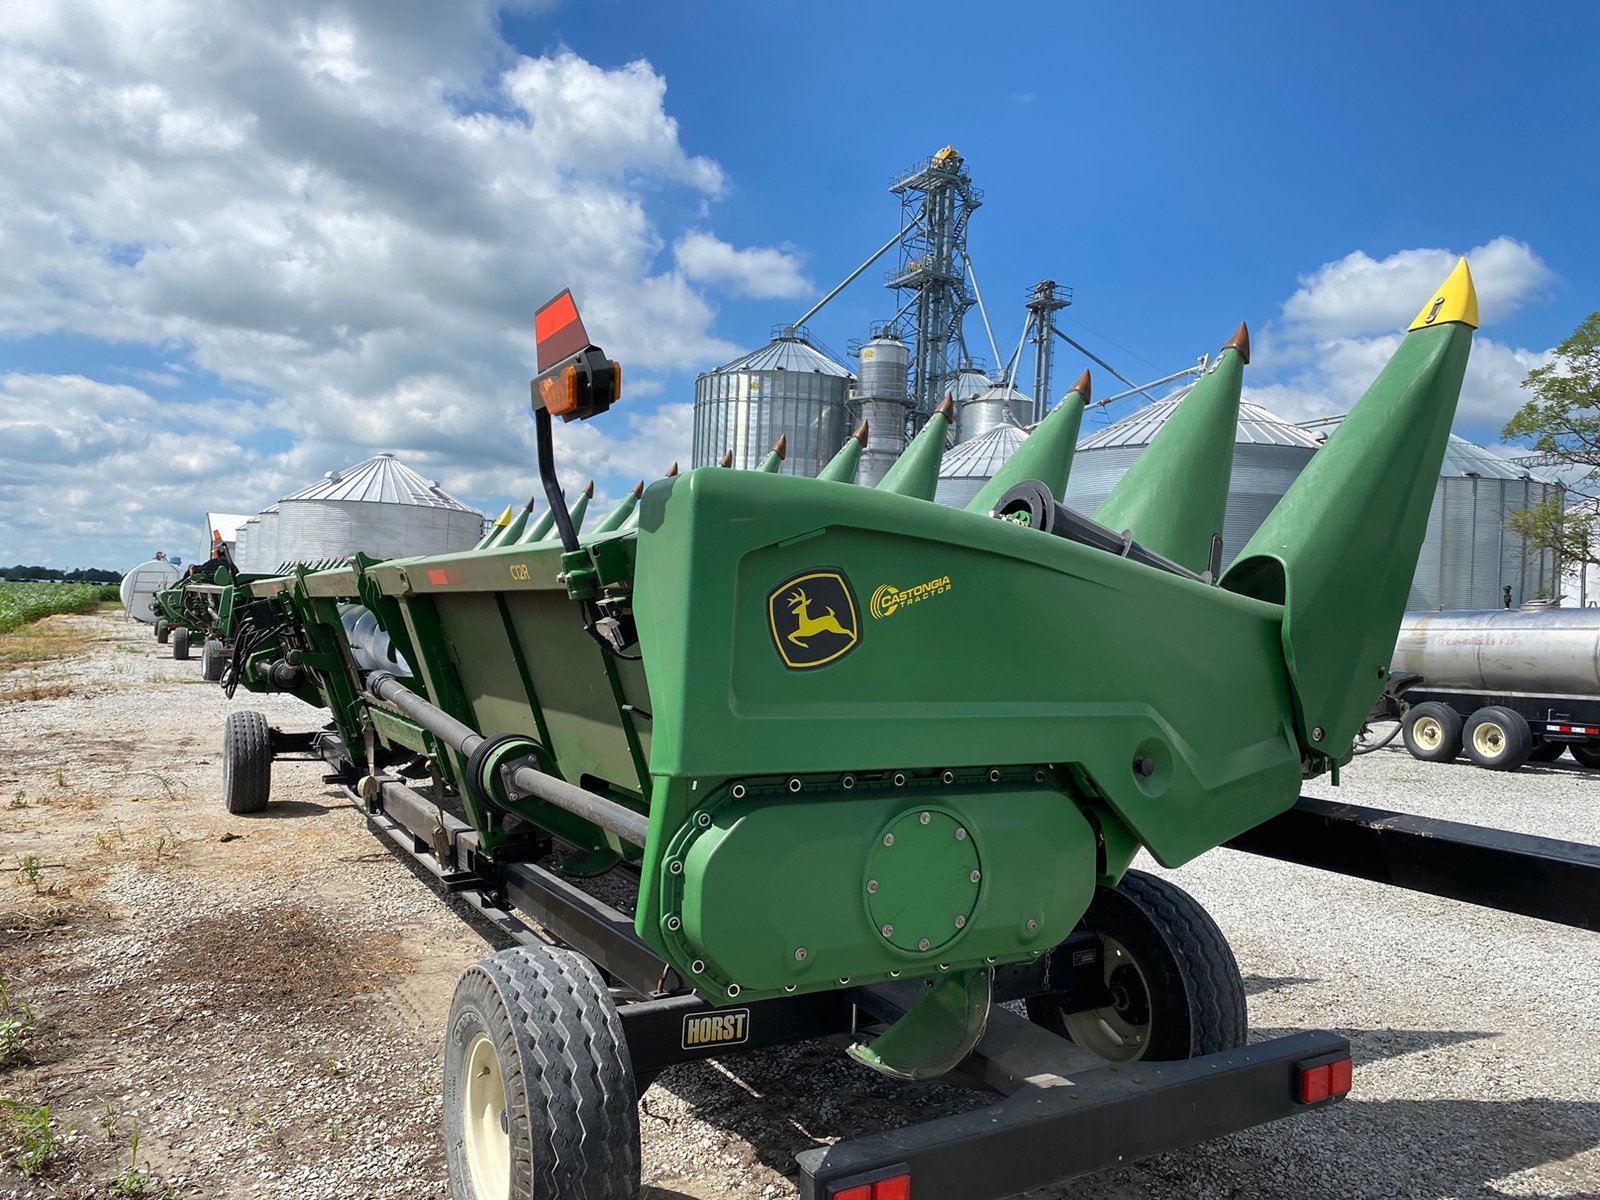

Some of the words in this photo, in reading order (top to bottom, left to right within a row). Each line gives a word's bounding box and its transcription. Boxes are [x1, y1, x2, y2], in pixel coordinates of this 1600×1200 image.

[510, 563, 531, 580] C12R
[881, 575, 951, 608] CASTONGIA
[900, 584, 952, 608] TRACTOR
[687, 1013, 746, 1045] HORST
